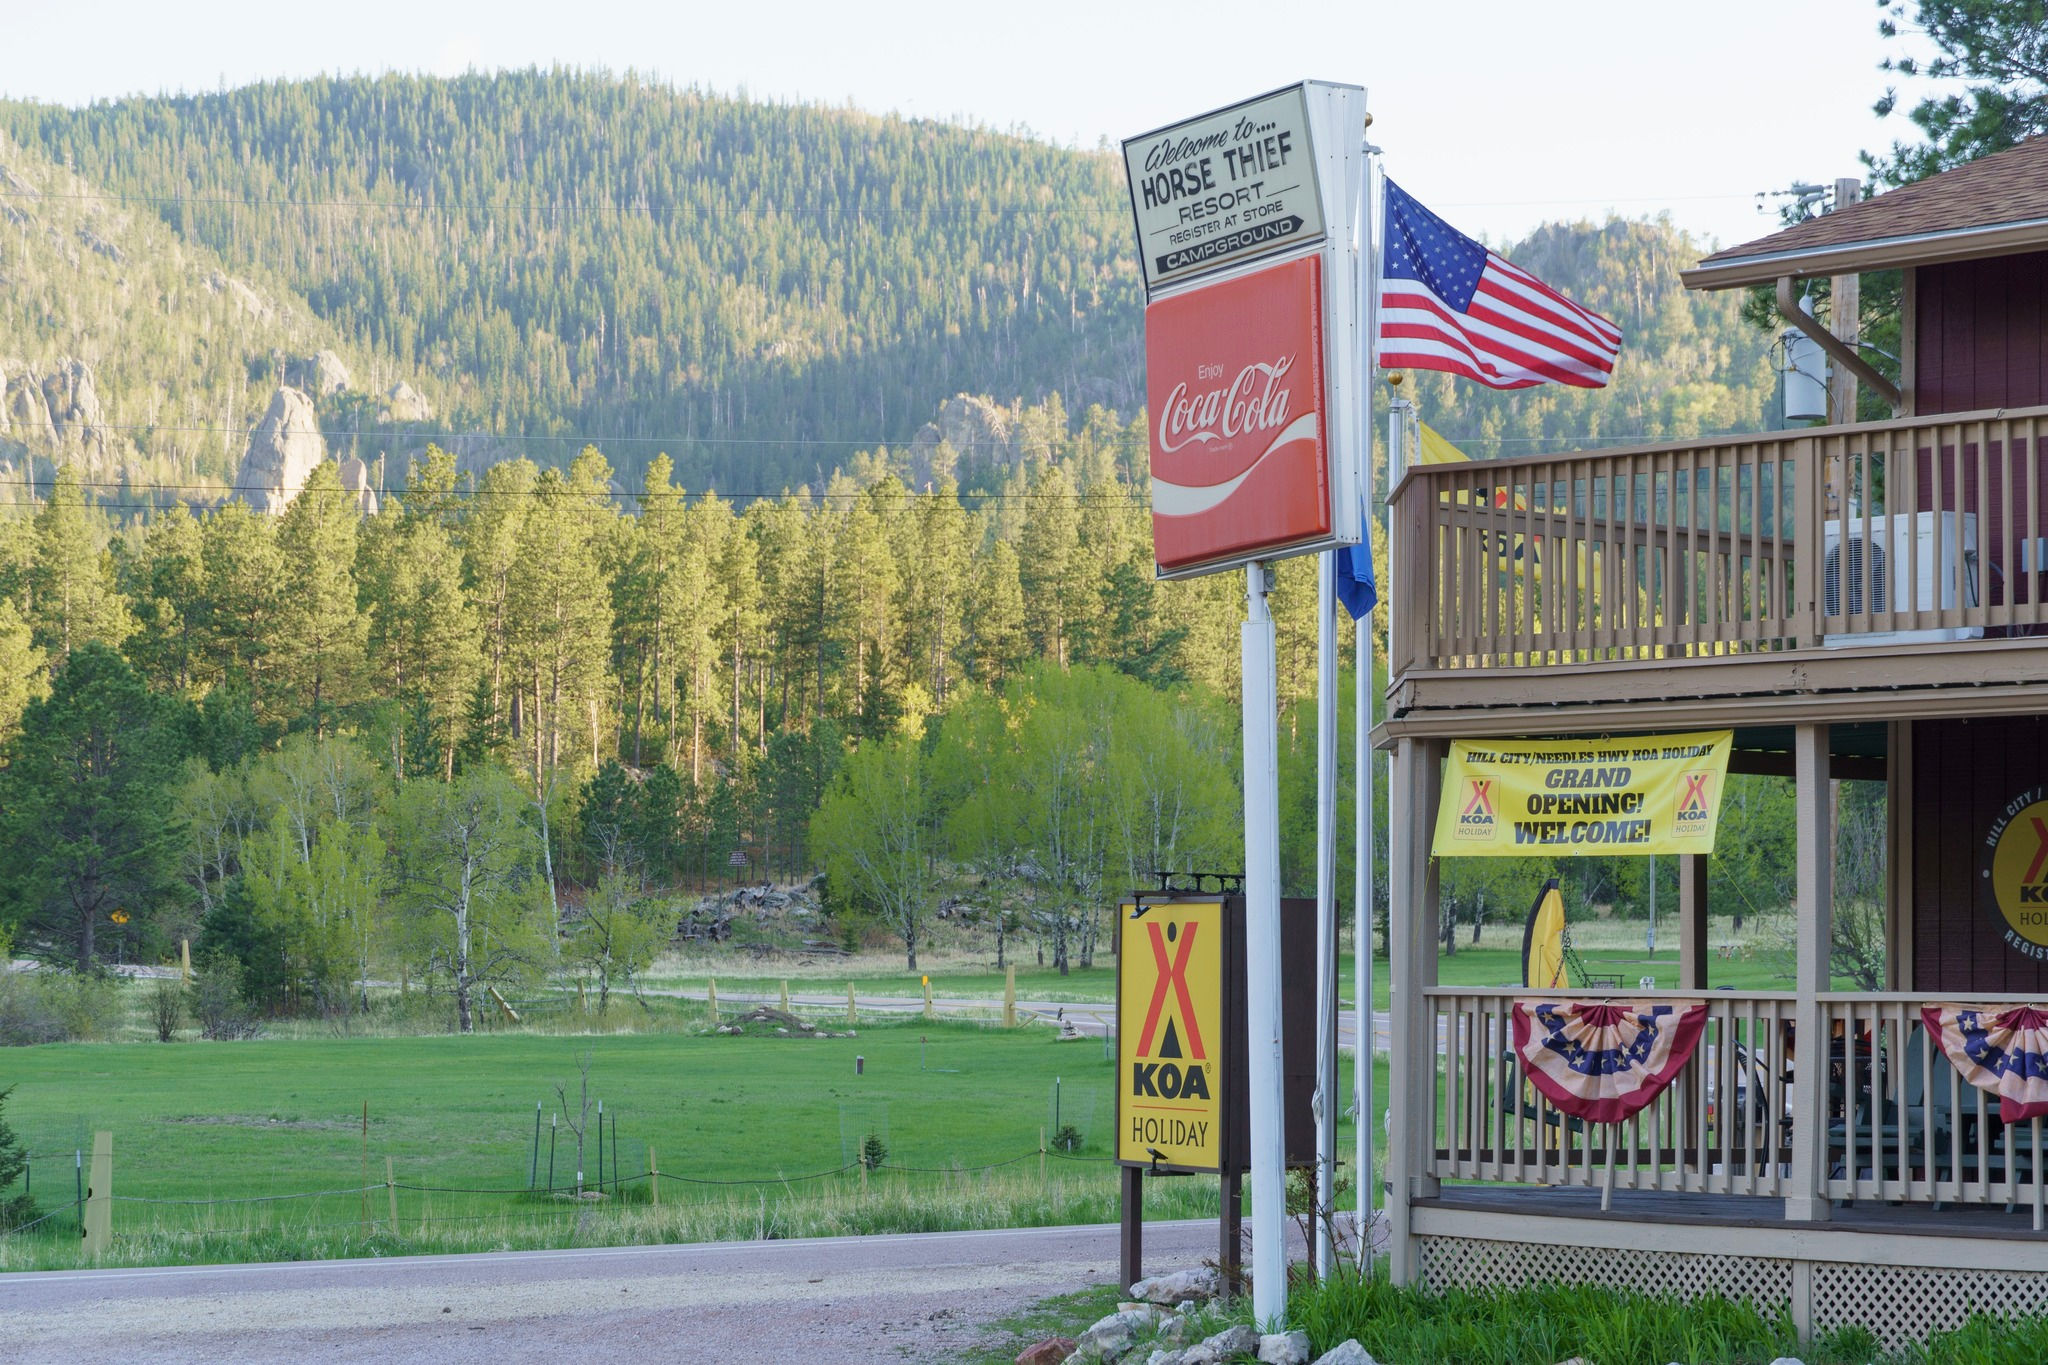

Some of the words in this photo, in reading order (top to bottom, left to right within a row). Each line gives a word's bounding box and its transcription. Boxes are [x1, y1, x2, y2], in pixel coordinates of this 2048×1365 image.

[1145, 131, 1229, 172] Welcome
[1141, 157, 1216, 210] HORSE
[1223, 130, 1292, 181] THIEF
[1179, 182, 1265, 225] RESORT
[1169, 219, 1221, 245] REGISTER
[1224, 214, 1238, 229] AT
[1243, 200, 1284, 223] STORE
[1166, 219, 1293, 269] CAMPGROUND
[1198, 363, 1224, 380] Enjoy
[1159, 352, 1297, 453] Coca-Cola
[1466, 752, 1496, 764] HILL
[1500, 751, 1595, 766] CITY/NEEDLES
[1597, 749, 1629, 764] HWY
[1632, 748, 1659, 761] KOA
[1661, 744, 1714, 760] HOLIDAY
[1545, 767, 1632, 789] GRAND
[1527, 792, 1645, 815] OPENING!
[1677, 810, 1708, 821] KOA
[1458, 827, 1493, 836] HOLIDAY
[1460, 815, 1494, 825] KOA
[1514, 819, 1652, 844] WELCOME!
[1675, 823, 1706, 833] HOLIDAY
[1986, 817, 2007, 848] HILL
[2006, 791, 2032, 816] CITY
[1133, 1062, 1211, 1100] KOA
[1132, 1117, 1208, 1147] HOLIDAY
